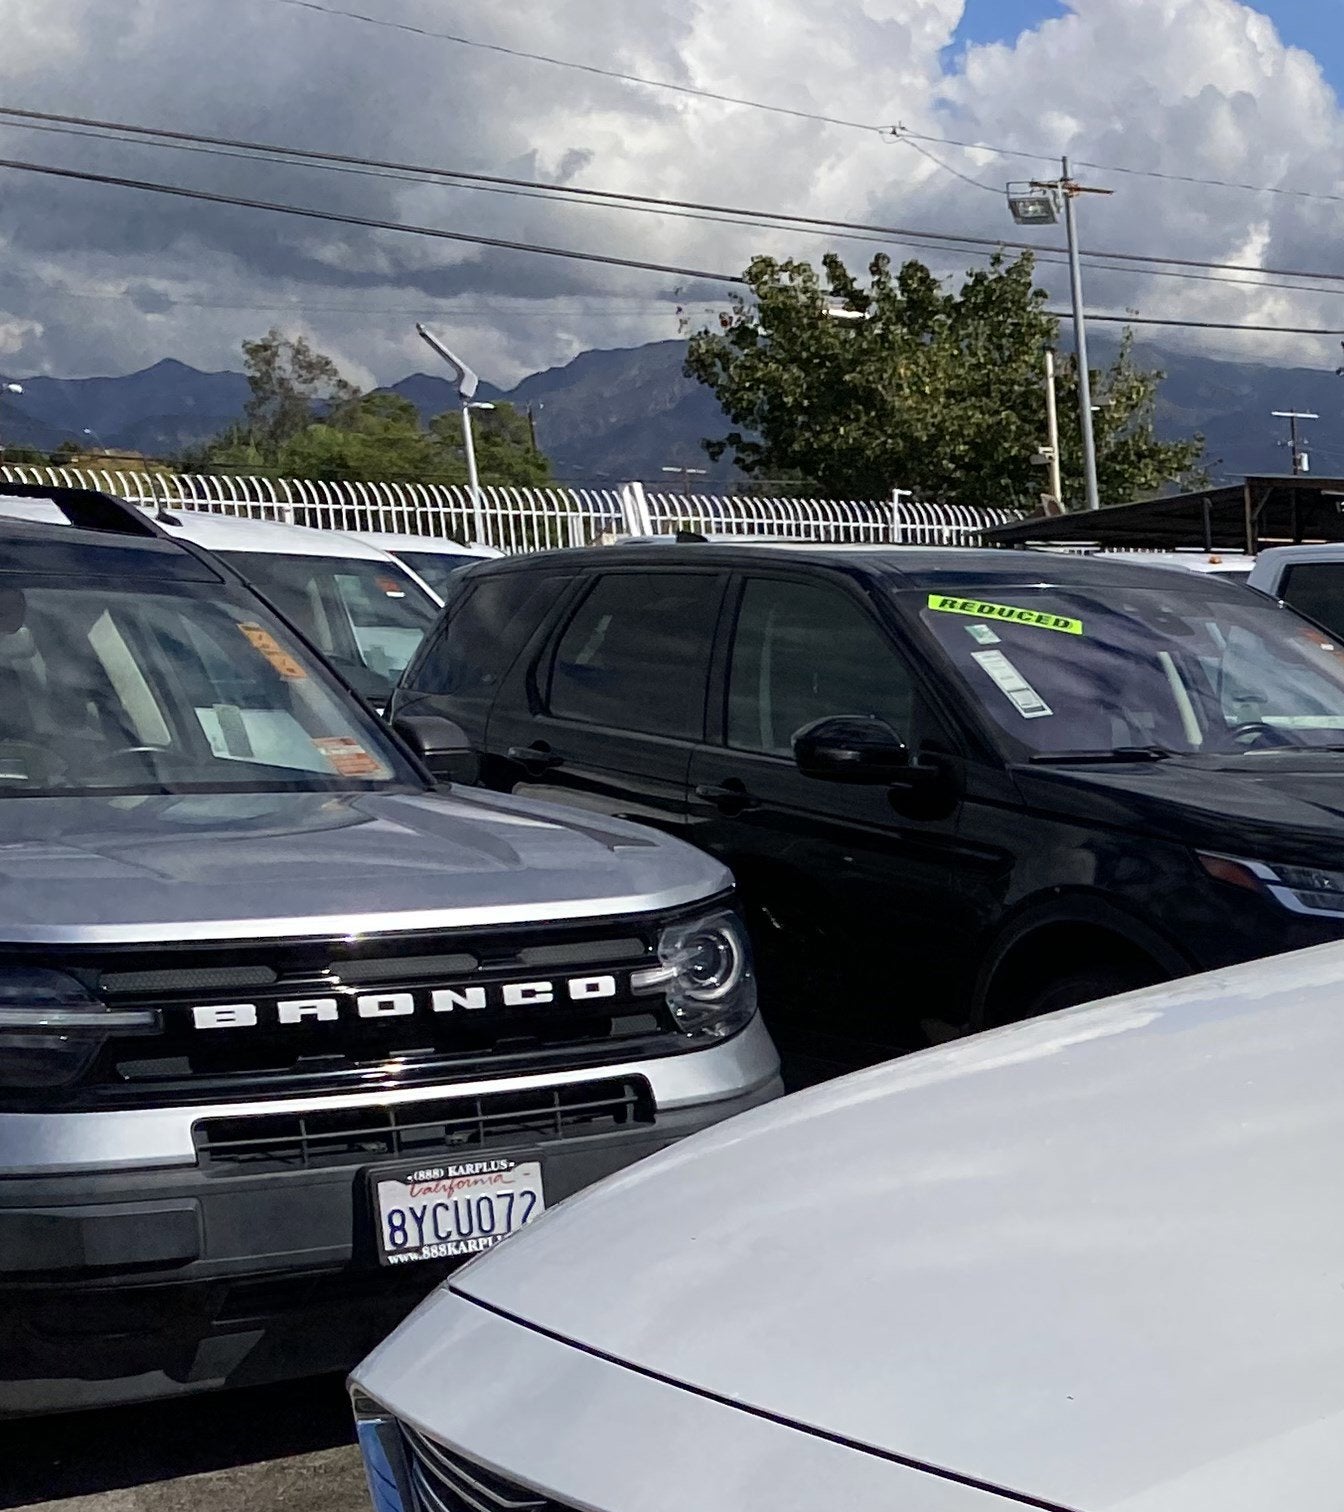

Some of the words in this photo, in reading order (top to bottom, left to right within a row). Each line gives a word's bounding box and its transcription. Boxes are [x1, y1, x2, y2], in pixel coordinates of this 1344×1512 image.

[938, 598, 1071, 629] REDUCED
[193, 975, 617, 1029] BRONCO
[413, 1167, 445, 1182] (888)
[448, 1158, 509, 1178] KARPLUS
[409, 1173, 516, 1199] California
[387, 1189, 537, 1248] 8YCU072
